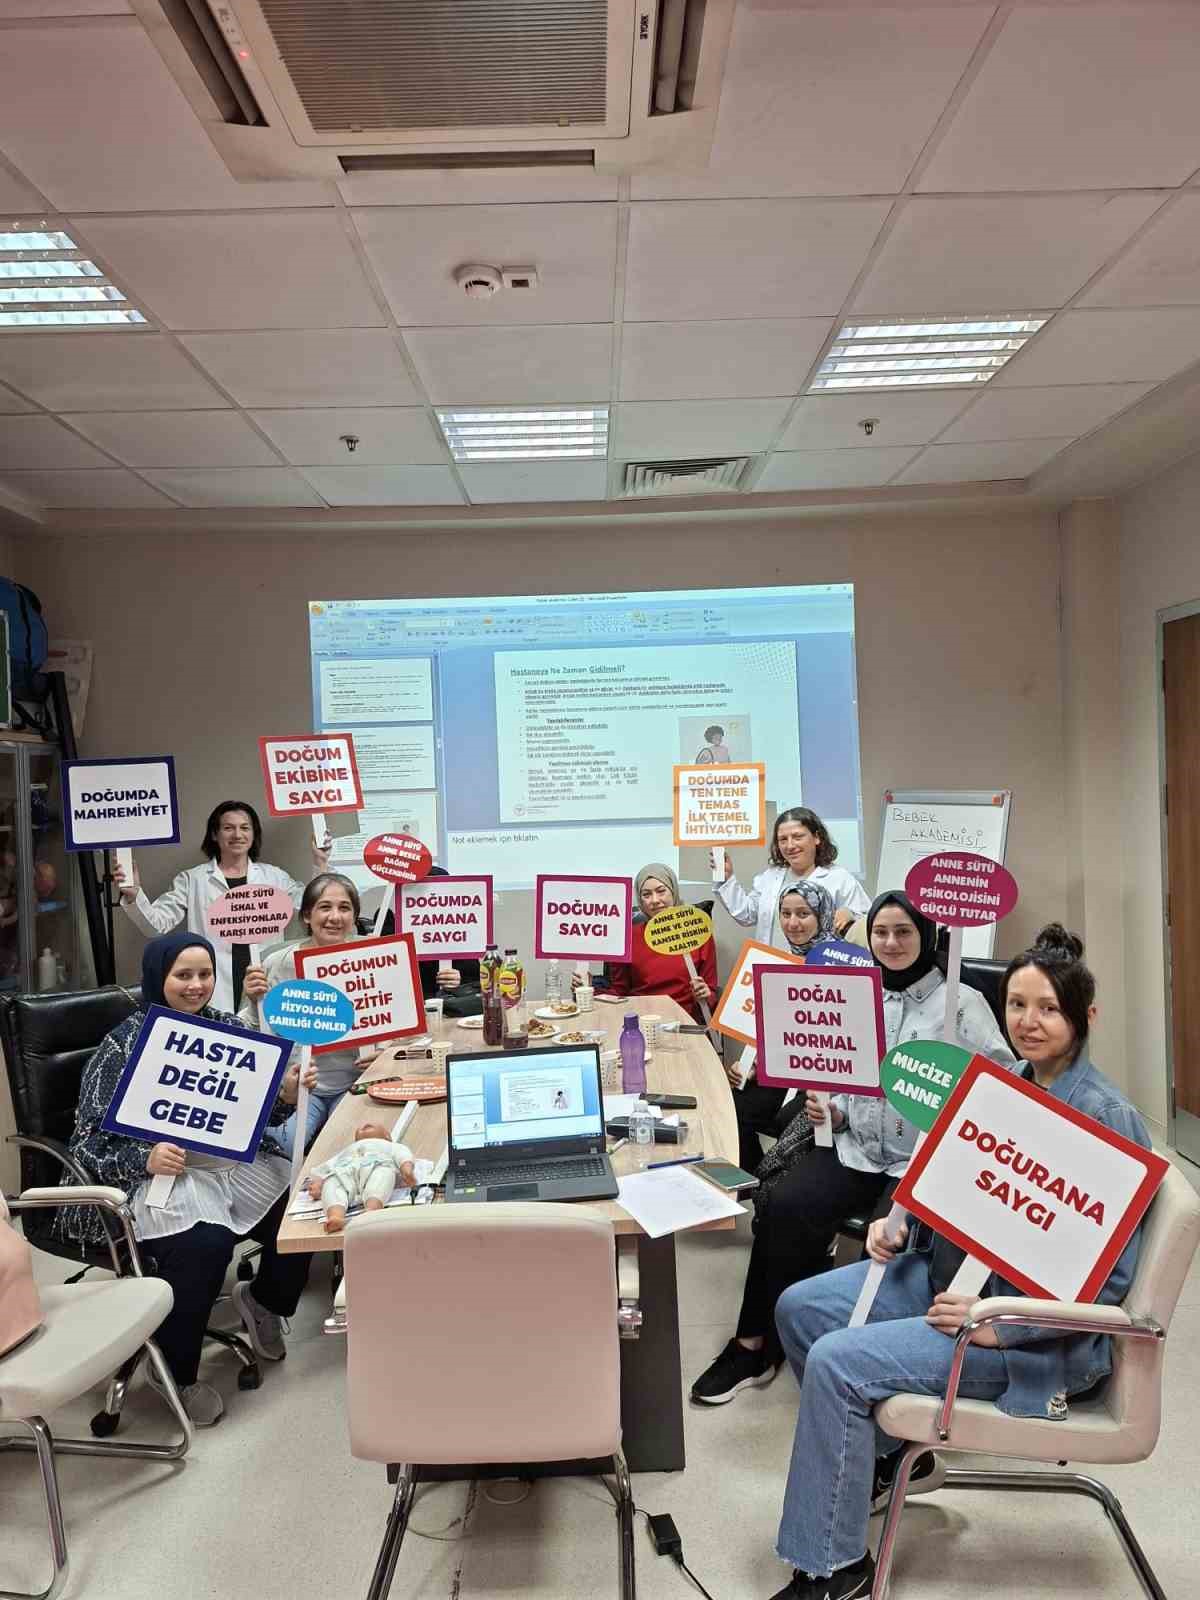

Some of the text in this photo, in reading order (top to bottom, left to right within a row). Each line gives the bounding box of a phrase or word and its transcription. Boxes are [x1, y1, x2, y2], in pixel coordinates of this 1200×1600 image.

[562, 666, 587, 674] Zaman
[274, 744, 342, 763] DOĞUM
[274, 765, 349, 785] EKİBİNE
[687, 773, 750, 785] DOĞUMDA
[81, 788, 160, 803] DOĞUMDA
[288, 788, 343, 805] SAYGI
[689, 787, 749, 798] TEN TENE
[74, 803, 168, 820] MAHREMİYET
[698, 800, 740, 810] TEMAS
[688, 810, 749, 822] İLK TEMEL
[892, 807, 938, 823] BEBEK
[685, 822, 752, 837] İHTİYAÇTIR
[930, 857, 995, 874] ANNE SÜTÜ
[934, 873, 988, 889] ANNENİN
[224, 888, 274, 900] ANNE SÜTÜ
[405, 893, 483, 908] DOĞUMDA
[920, 887, 1000, 906] PSİKOLOJİSİNİ
[231, 901, 269, 912] İSHAL VE
[547, 899, 620, 917] DOĞUMA
[920, 902, 997, 921] GÜÇLÜ TUTAR
[210, 912, 288, 925] ENFEKSİYONLARA
[410, 912, 478, 926] ZAMANA
[654, 906, 694, 925] ANNE SÜTÜ
[220, 926, 279, 939] KARŞI KORUR
[559, 923, 608, 937] SAYGI
[651, 917, 704, 936] MEME VE OVER
[422, 931, 467, 943] SAYGI
[651, 934, 681, 946] KANSER
[668, 939, 699, 953] AZALTIR
[822, 947, 850, 962] ANNE
[316, 953, 398, 978] DOĞUMUN
[345, 972, 375, 993] DİLİ
[282, 988, 337, 1002] ANNE SÜTÜ
[351, 990, 393, 1010] ZİTİF
[787, 984, 847, 1004] DOĞAL
[281, 999, 337, 1017] FİZYOLOJİK
[269, 1015, 347, 1032] SARILIĞI ÖNLER
[794, 1010, 842, 1026] OLAN
[783, 1031, 857, 1051] NORMAL
[164, 1031, 257, 1072] HASTA
[789, 1053, 853, 1074] DOĞUM
[891, 1051, 953, 1088] MUCİZE
[157, 1064, 239, 1103] DEĞİL
[891, 1078, 942, 1110] ANNE
[149, 1099, 228, 1135] GEBE
[957, 1119, 1106, 1227] DOĞURANA
[974, 1169, 1057, 1232] SAYGI
